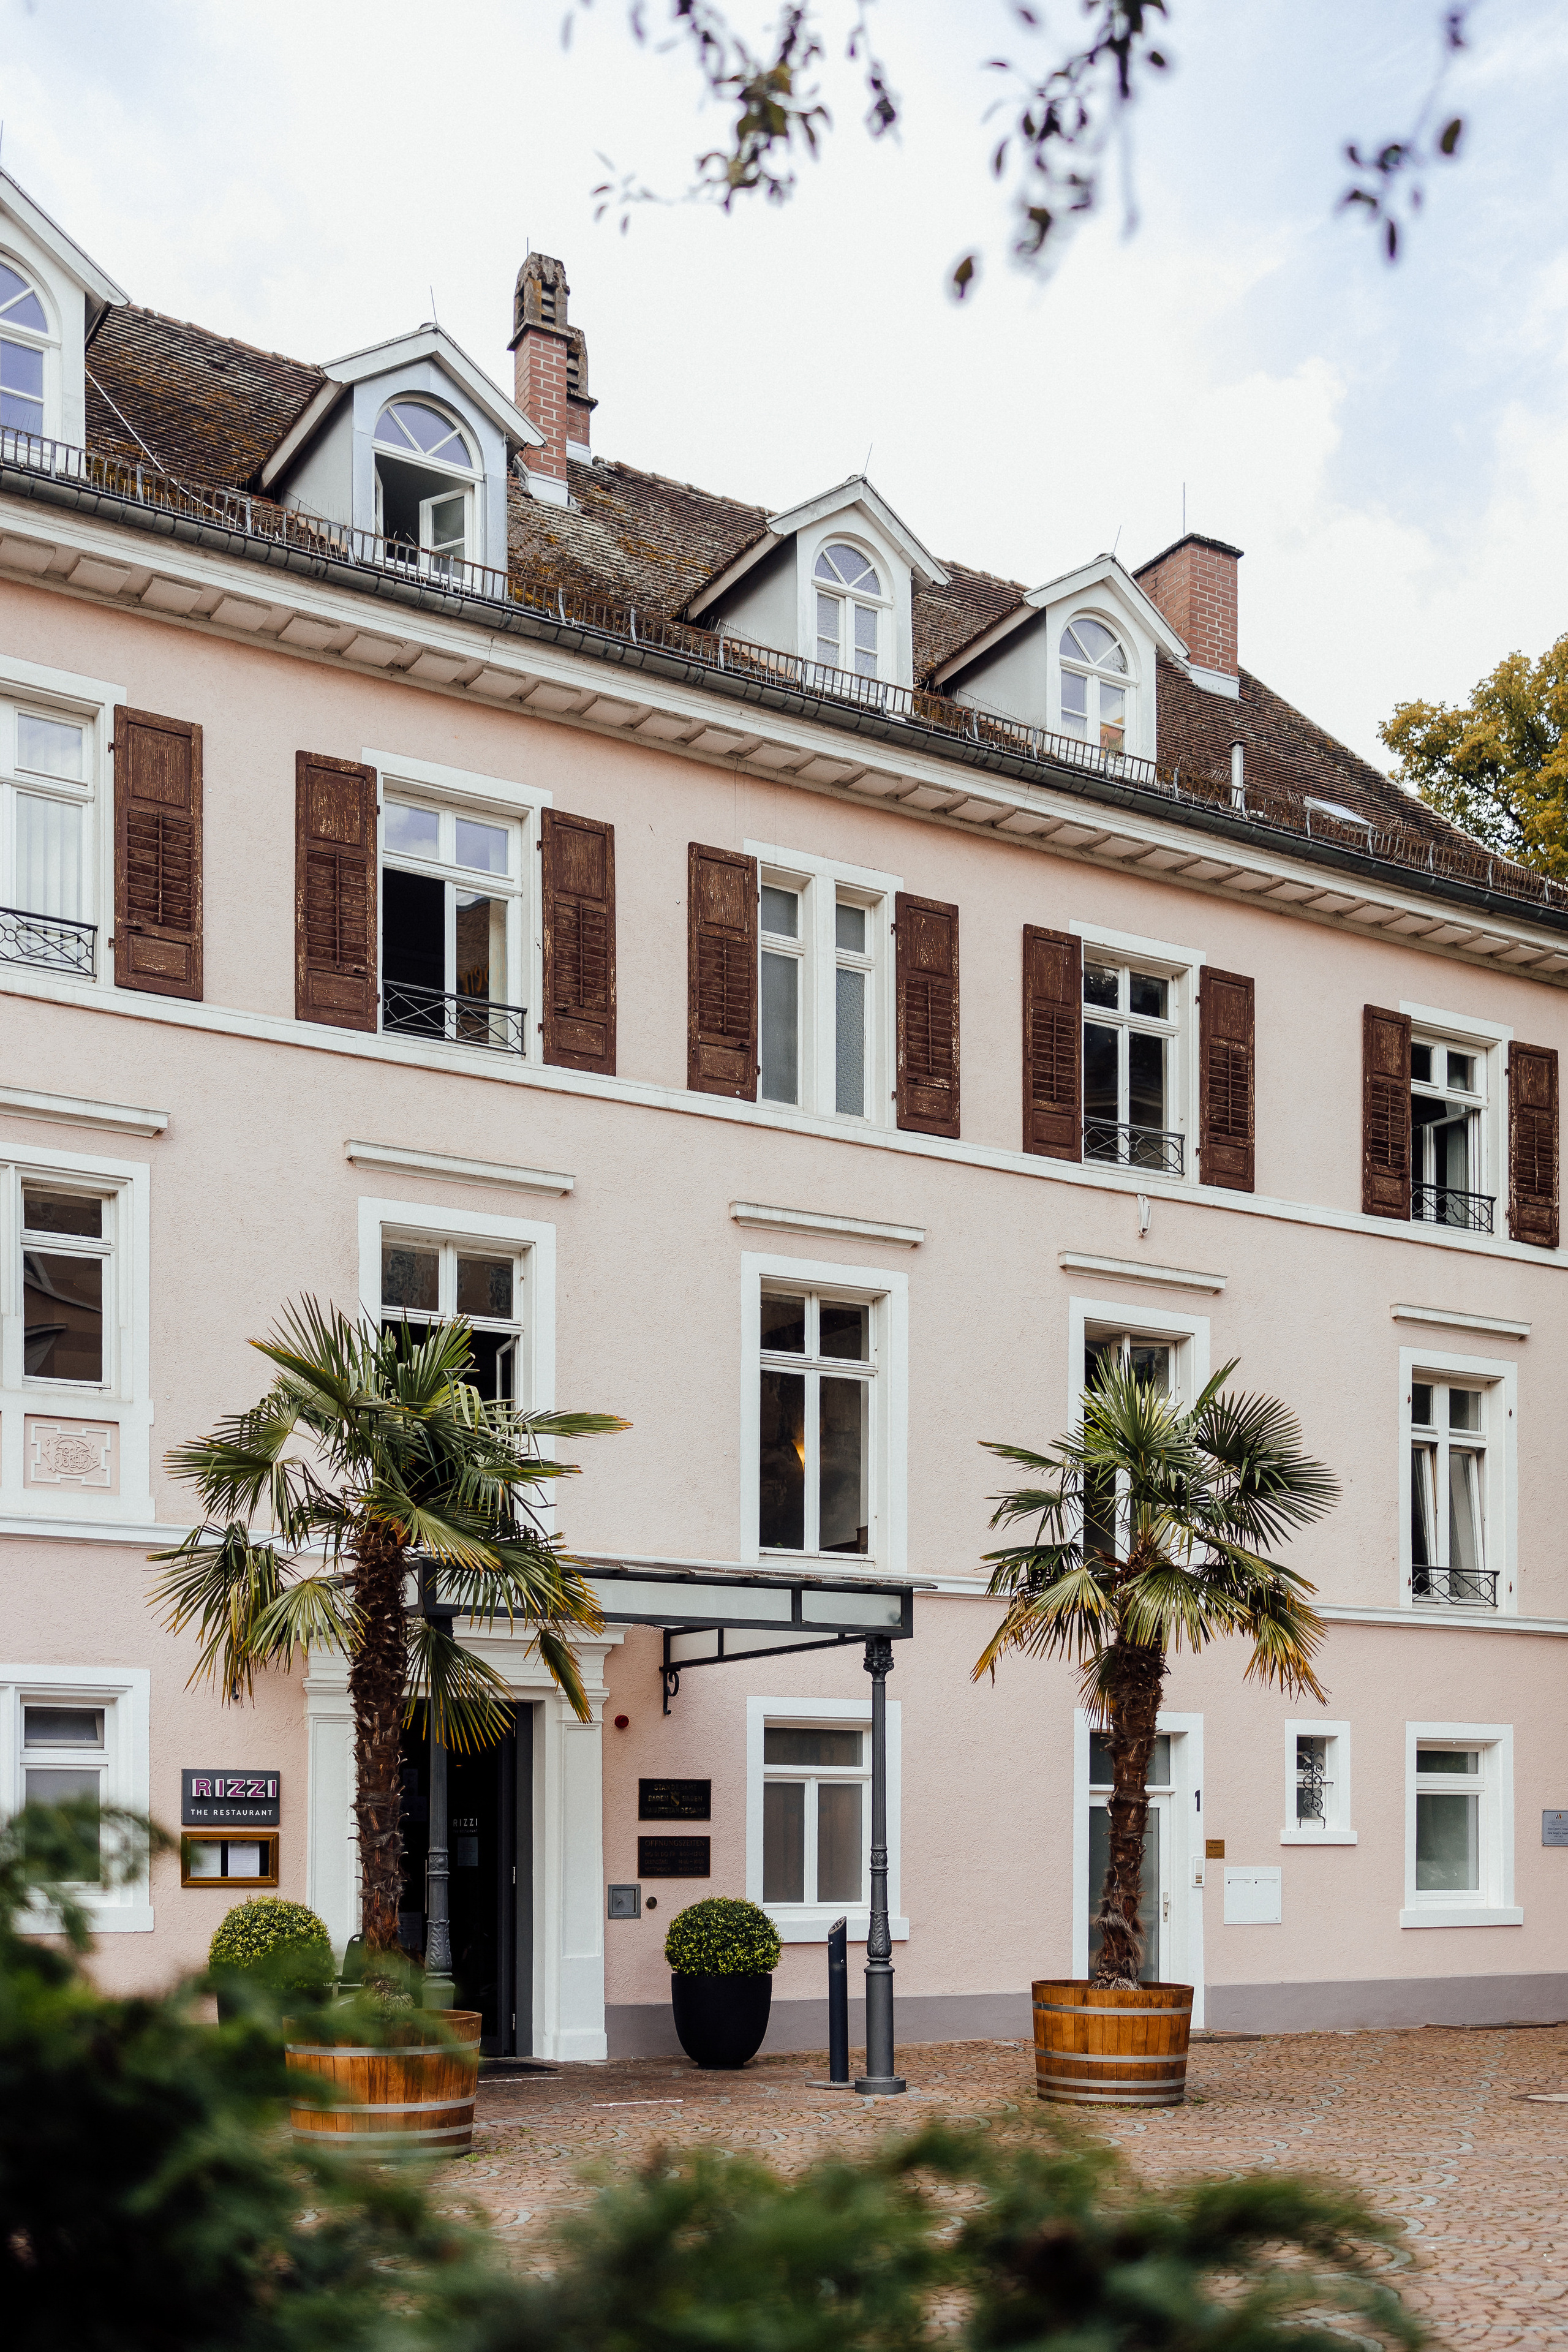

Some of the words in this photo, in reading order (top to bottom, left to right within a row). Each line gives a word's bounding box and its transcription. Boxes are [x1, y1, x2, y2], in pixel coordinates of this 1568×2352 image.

[192, 1778, 277, 1798] RIZZI
[1194, 1789, 1200, 1812] 1
[453, 1818, 478, 1827] RIZZI
